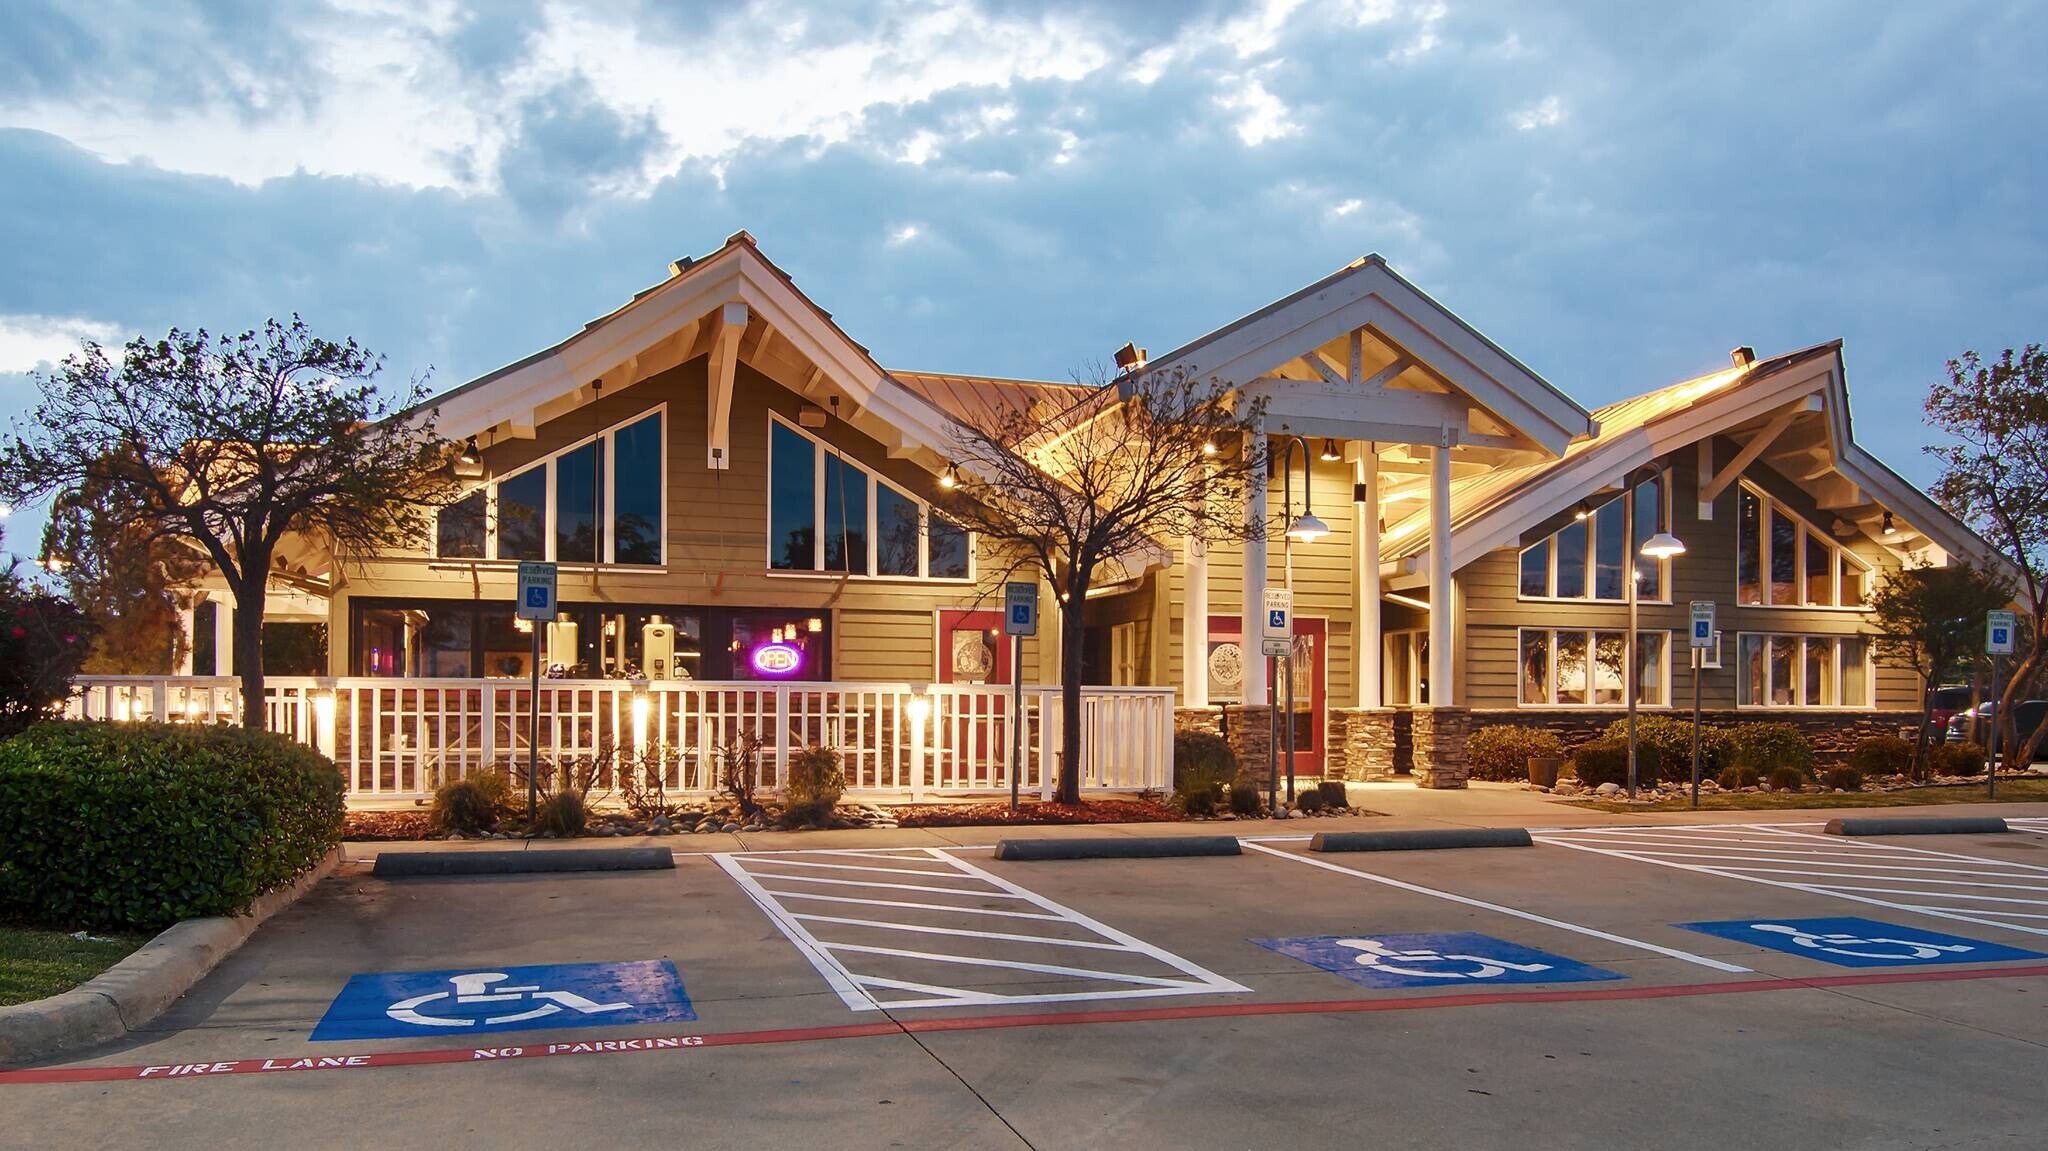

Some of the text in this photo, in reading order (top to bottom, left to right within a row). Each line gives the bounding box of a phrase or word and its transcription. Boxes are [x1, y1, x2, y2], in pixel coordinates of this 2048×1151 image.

[521, 566, 555, 575] RESERVED
[522, 575, 552, 584] PARKING
[1009, 595, 1034, 603] PARKING
[1265, 592, 1291, 600] RESERVED
[1266, 600, 1289, 608] PARKING
[759, 651, 796, 668] OPEN
[473, 1036, 704, 1059] NO PARKING
[138, 1055, 372, 1077] FIRE LANE
